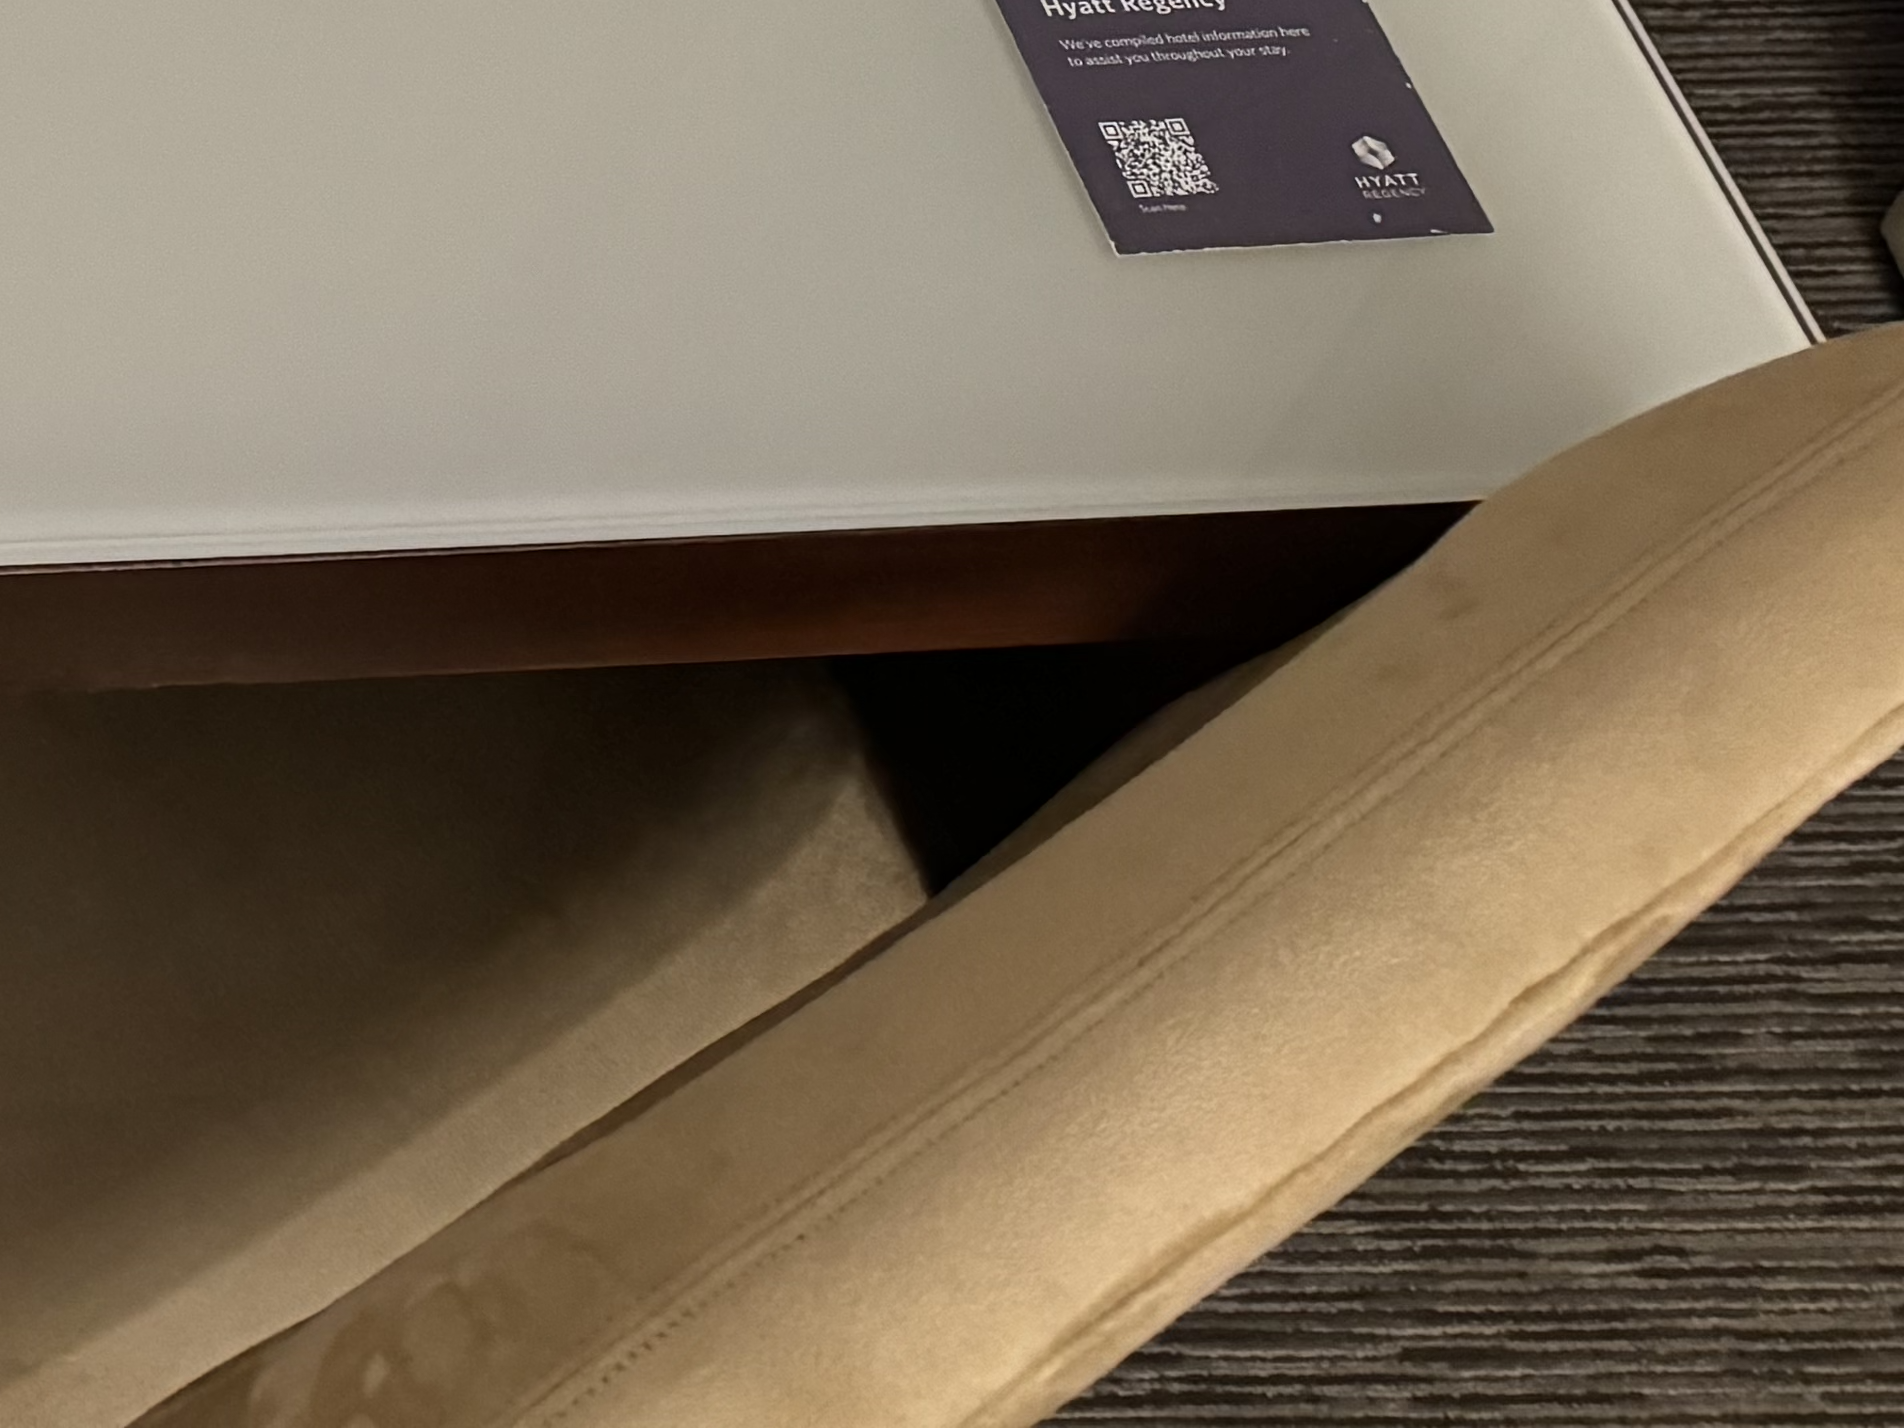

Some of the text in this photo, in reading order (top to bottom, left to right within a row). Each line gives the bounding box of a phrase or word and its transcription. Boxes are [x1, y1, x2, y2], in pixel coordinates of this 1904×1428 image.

[1104, 33, 1164, 48] compiled
[1165, 30, 1199, 44] hotel
[1201, 28, 1279, 42] information
[1278, 26, 1311, 38] here
[1067, 56, 1083, 67] to
[1085, 52, 1124, 66] assist
[1124, 53, 1151, 66] you
[1151, 48, 1226, 63] throughout
[1226, 47, 1256, 59] your
[1354, 173, 1420, 189] HYATT
